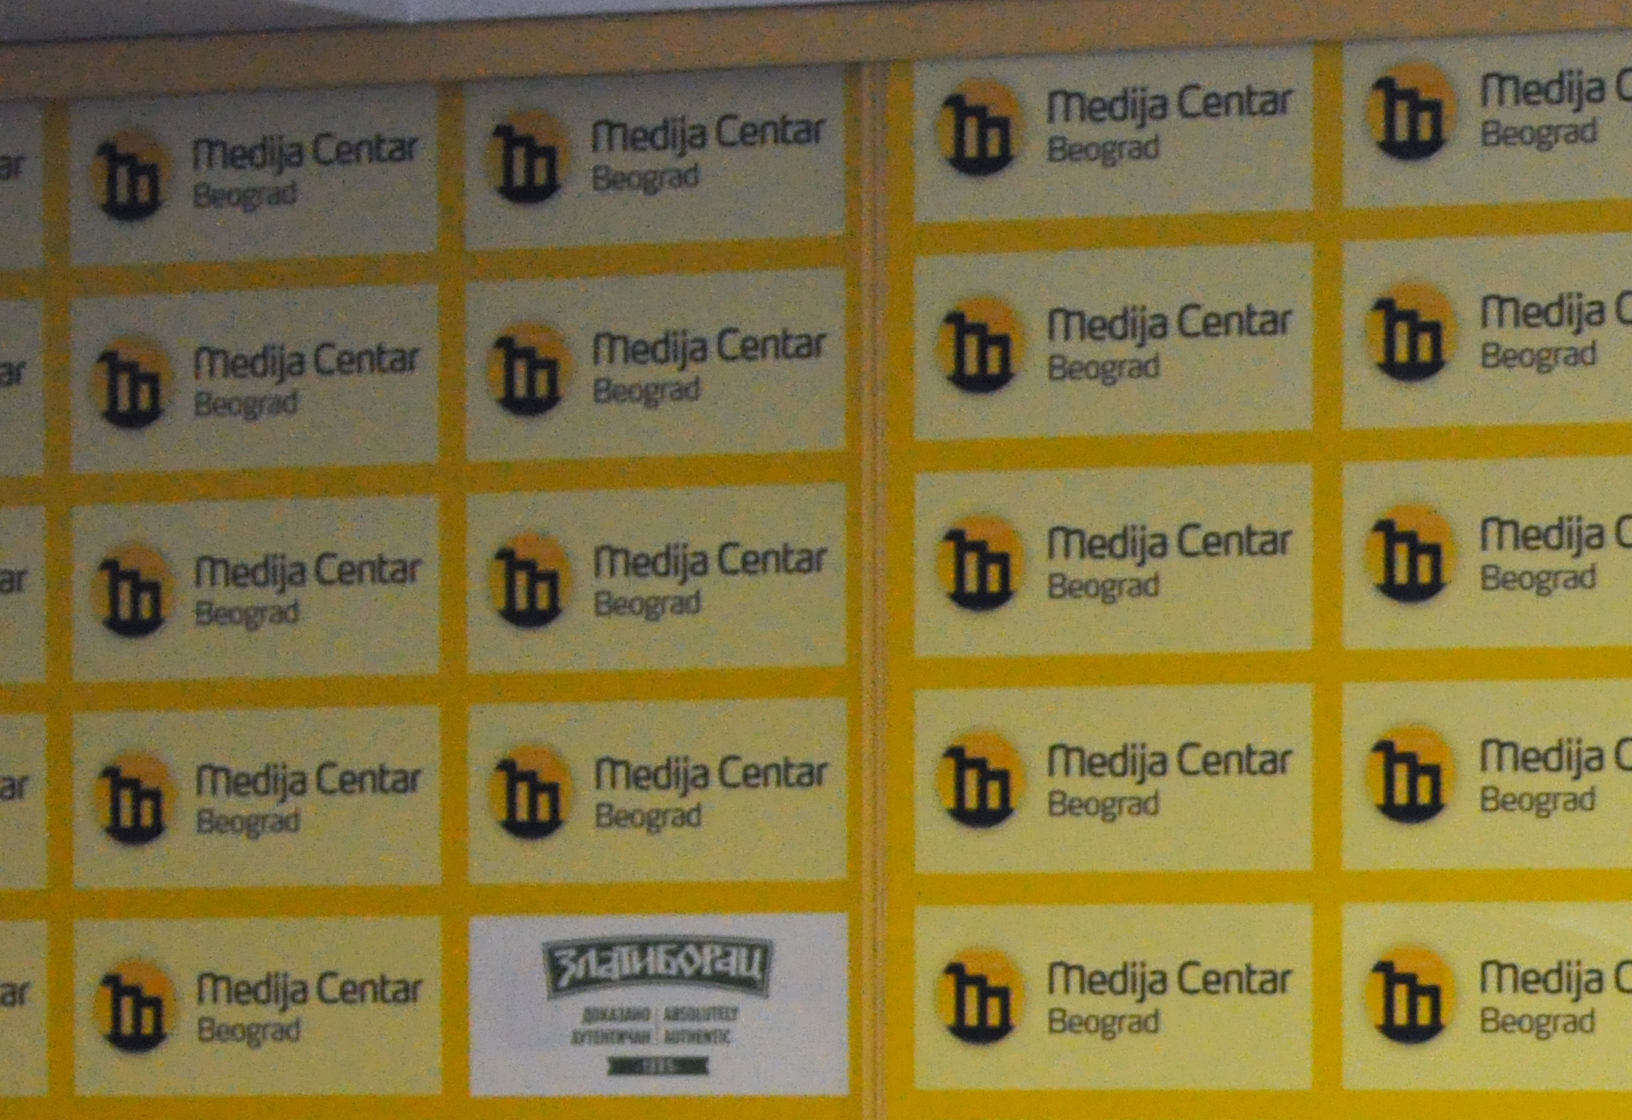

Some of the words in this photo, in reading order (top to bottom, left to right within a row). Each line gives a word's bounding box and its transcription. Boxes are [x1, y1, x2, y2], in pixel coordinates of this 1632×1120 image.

[1047, 86, 1169, 130] Medija
[1177, 83, 1293, 120] Centar
[1480, 69, 1606, 114] Medija
[192, 135, 305, 176] Medija
[312, 131, 419, 167] Centar
[591, 115, 708, 159] Medija
[715, 113, 826, 148] Centar
[1047, 135, 1160, 168] Beograd
[1480, 118, 1596, 152] Beograd
[1047, 305, 1169, 349] Medija
[1177, 302, 1293, 339] Centar
[1480, 292, 1606, 336] Medija
[193, 344, 306, 386] Medija
[313, 341, 420, 376] Centar
[592, 329, 709, 372] Medija
[716, 326, 827, 363] Centar
[1047, 354, 1160, 387] Beograd
[1480, 340, 1596, 374] Beograd
[1047, 524, 1169, 568] Medija
[1177, 522, 1293, 559] Centar
[1480, 515, 1606, 559] Medija
[194, 554, 307, 596] Medija
[314, 550, 421, 586] Centar
[594, 543, 709, 586] Medija
[717, 541, 828, 576] Centar
[1480, 564, 1596, 597] Beograd
[594, 590, 701, 622] Beograd
[1047, 572, 1160, 605] Beograd
[595, 754, 710, 799] Medija
[717, 755, 829, 790] Centar
[1047, 742, 1169, 786] Medija
[1177, 741, 1293, 777] Centar
[1480, 737, 1606, 782] Medija
[195, 763, 308, 804] Medija
[315, 760, 422, 796] Centar
[1480, 785, 1596, 819] Beograd
[196, 808, 300, 840] Beograd
[595, 802, 702, 834] Beograd
[1047, 790, 1160, 823] Beograd
[196, 971, 309, 1014] Medija
[316, 970, 423, 1005] Centar
[1047, 960, 1169, 1004] Medija
[1177, 959, 1293, 996] Centar
[1480, 959, 1606, 1004] Medija
[197, 1016, 301, 1048] Beograd
[663, 1005, 740, 1022] ABSOLUTELY
[1047, 1007, 1160, 1041] Beograd
[1480, 1006, 1596, 1041] Beograd
[663, 1028, 732, 1045] AUTHENTIC
